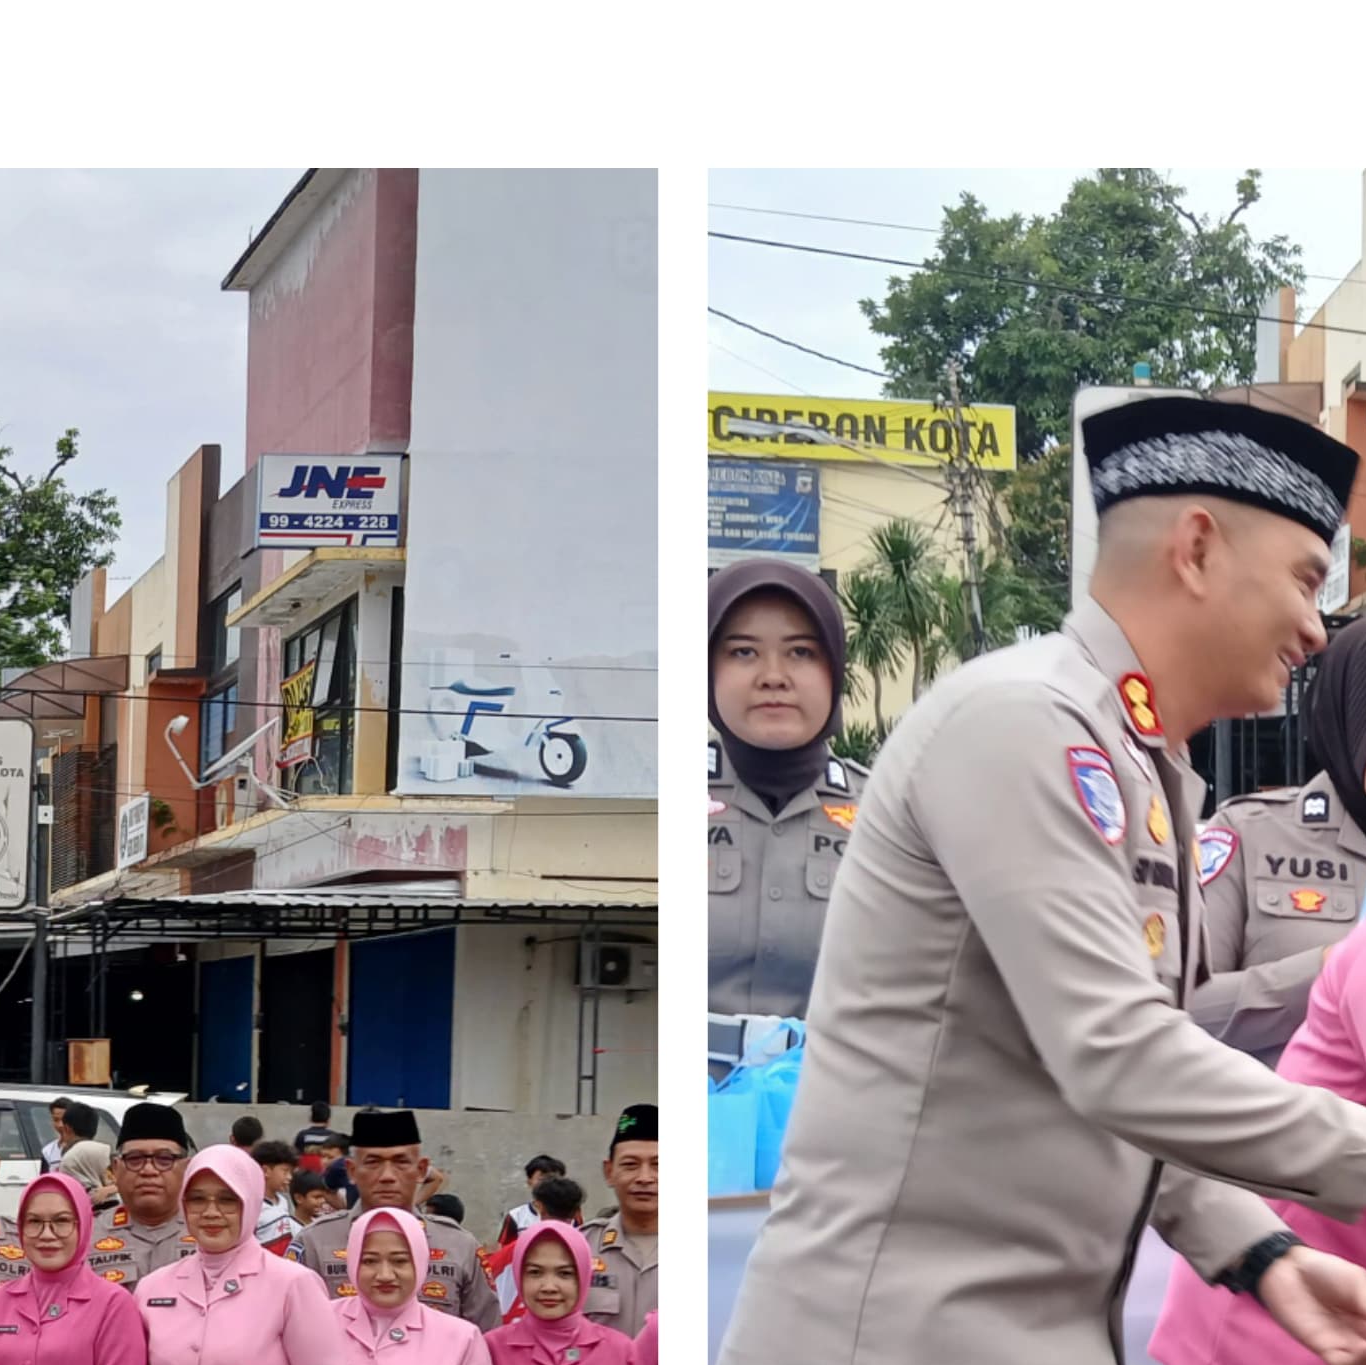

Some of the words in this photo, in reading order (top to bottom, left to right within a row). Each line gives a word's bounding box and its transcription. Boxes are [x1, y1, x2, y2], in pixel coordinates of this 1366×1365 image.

[277, 466, 386, 498] JNE
[332, 500, 372, 510] EXPRESS
[268, 515, 289, 529] 99
[303, 516, 344, 529] 4224
[359, 516, 389, 529] 228
